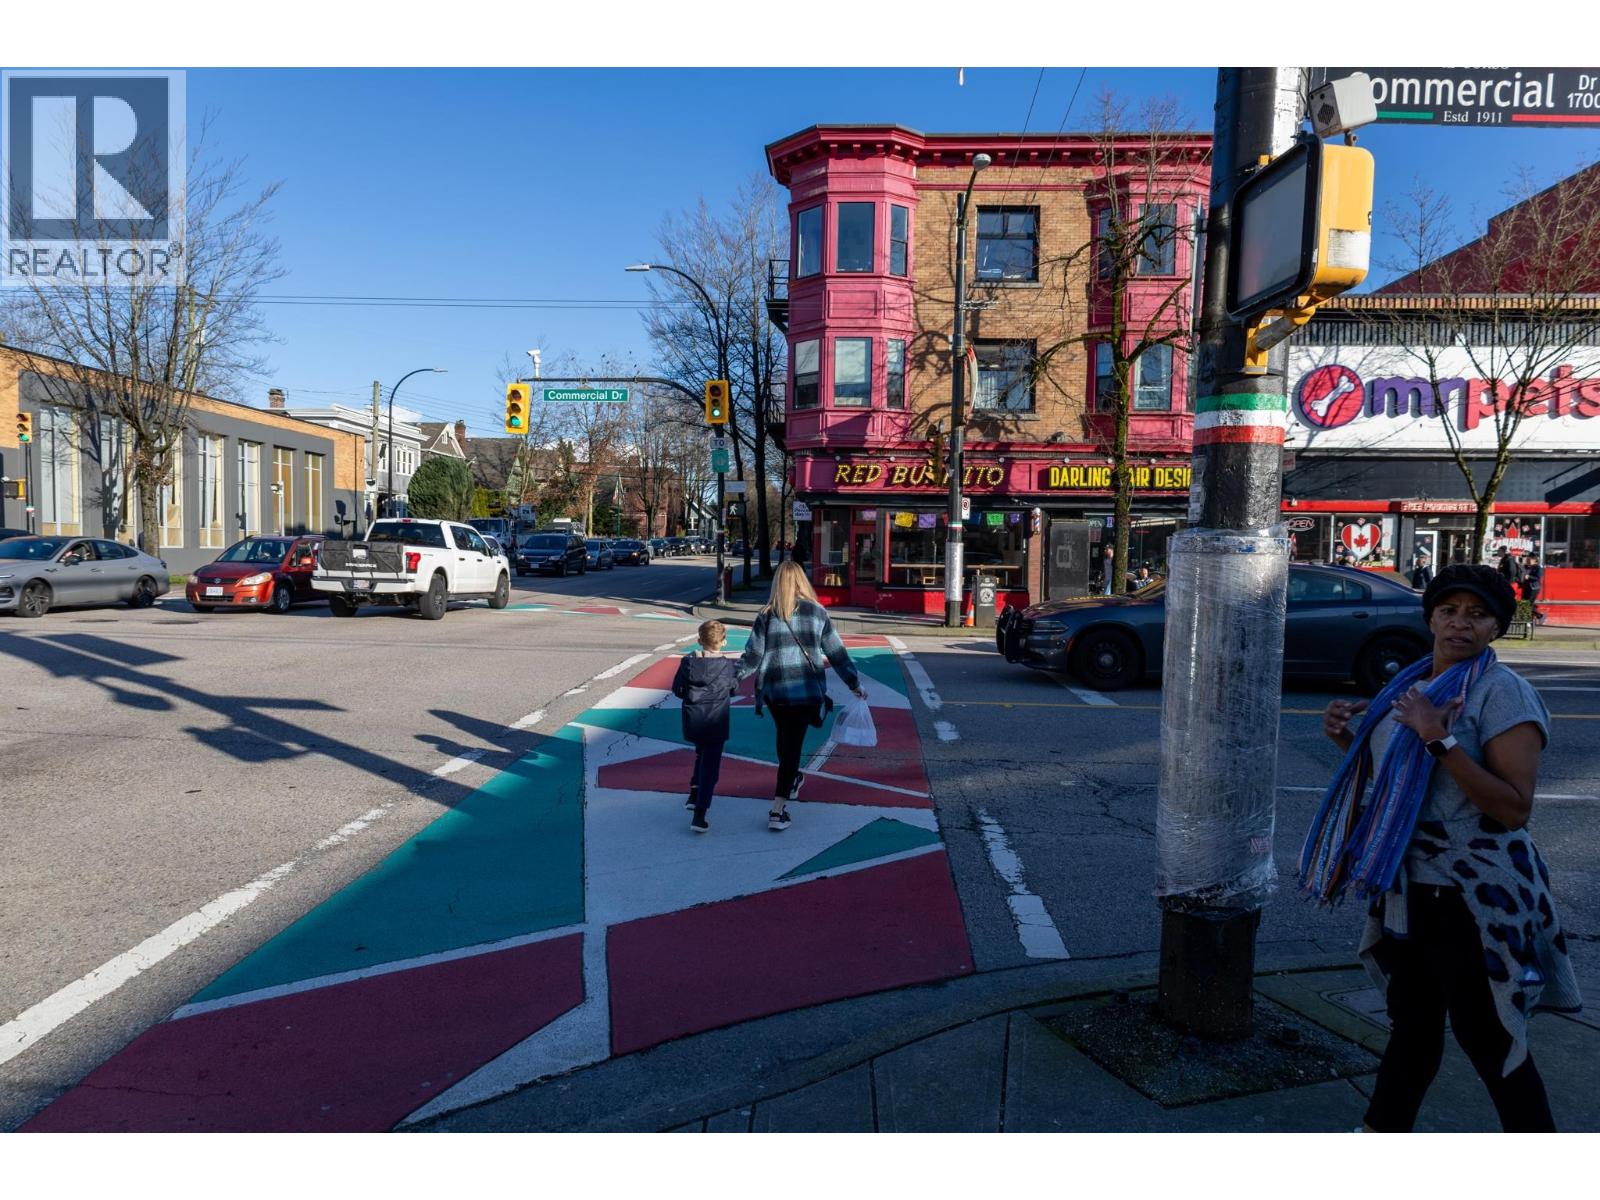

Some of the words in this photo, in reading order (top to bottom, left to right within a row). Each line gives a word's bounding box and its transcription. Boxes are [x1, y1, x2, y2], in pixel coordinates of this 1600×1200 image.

[1370, 72, 1556, 107] ommercial
[1578, 74, 1596, 91] Dr
[1443, 111, 1469, 123] Estd
[1476, 112, 1502, 123] 1911
[548, 390, 607, 400] Commercial
[611, 390, 624, 400] Dr
[714, 439, 725, 447] TO
[834, 464, 883, 484] RED
[892, 465, 1005, 486] BUITO
[1050, 466, 1111, 487] DARLING
[1127, 467, 1150, 487] AIR
[1287, 519, 1314, 528] OPEN
